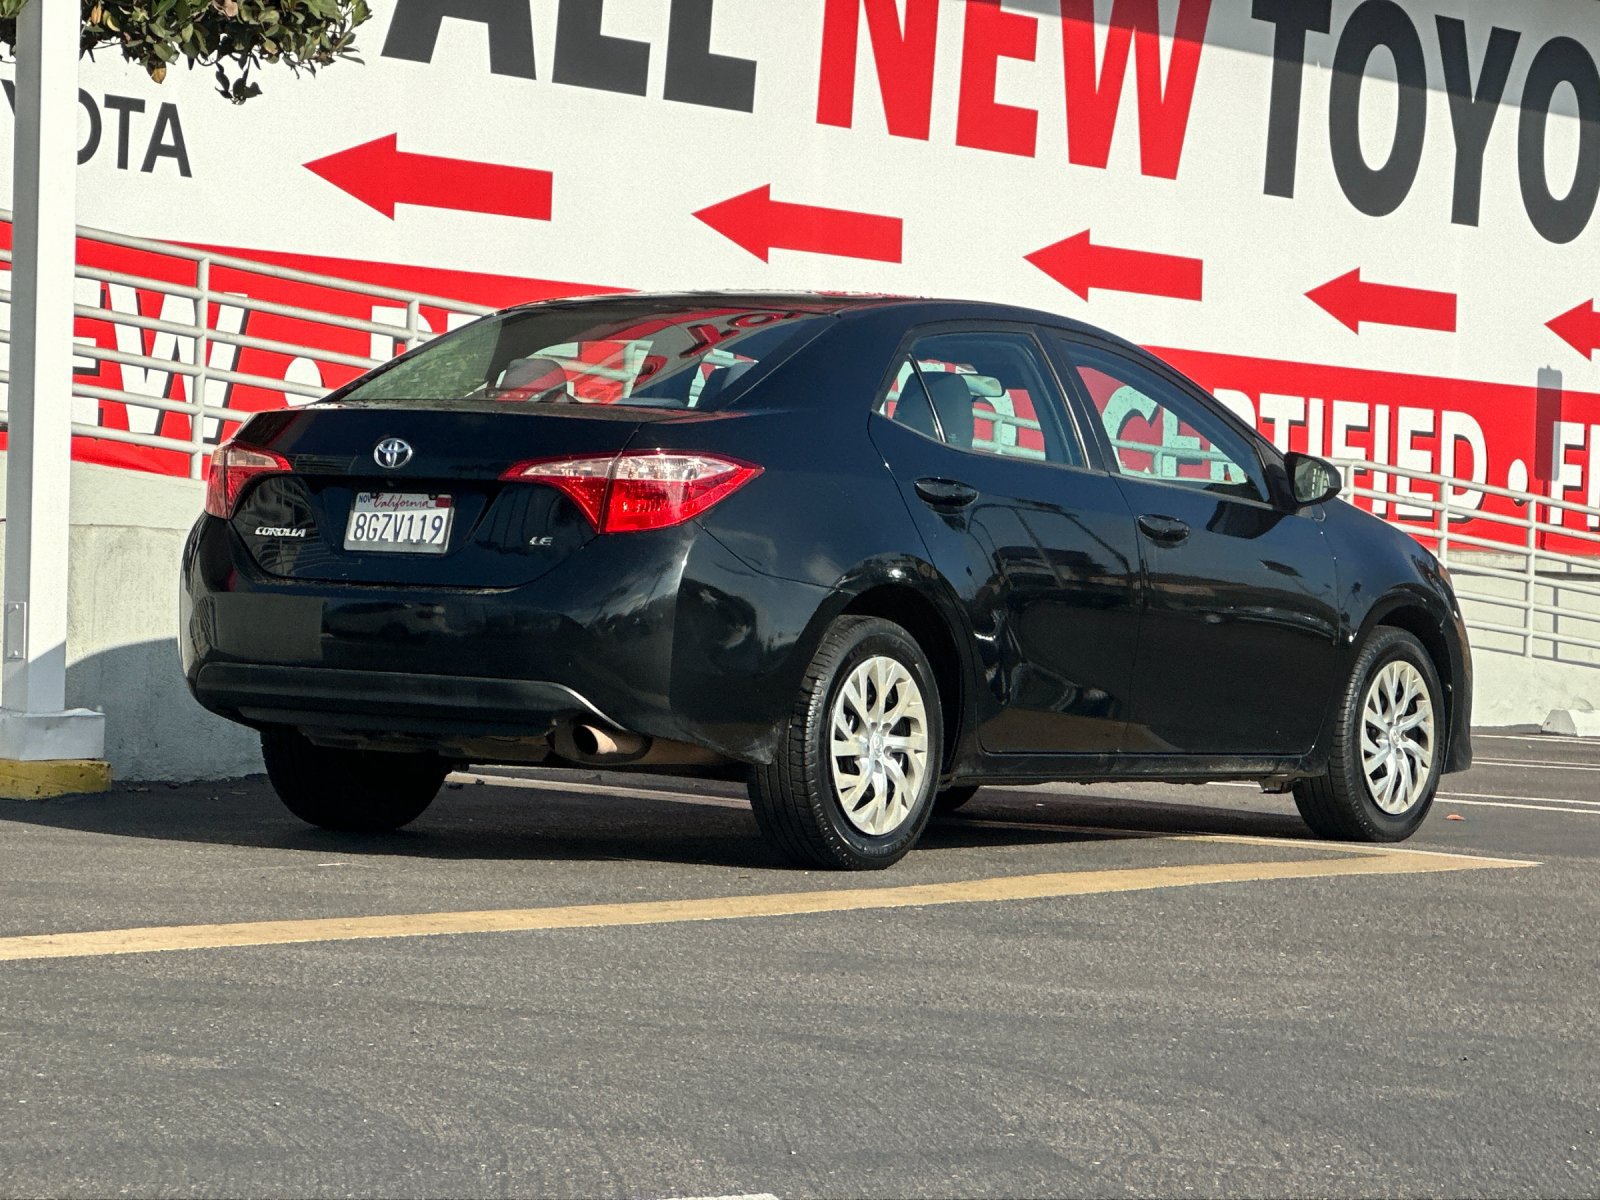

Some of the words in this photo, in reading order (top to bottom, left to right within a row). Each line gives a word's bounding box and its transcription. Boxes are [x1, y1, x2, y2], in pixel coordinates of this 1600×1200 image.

[816, 0, 1208, 180] NEW
[373, 492, 434, 511] California
[254, 526, 307, 538] COROLLA
[353, 512, 444, 543] 8GZV119
[529, 536, 553, 546] LE
